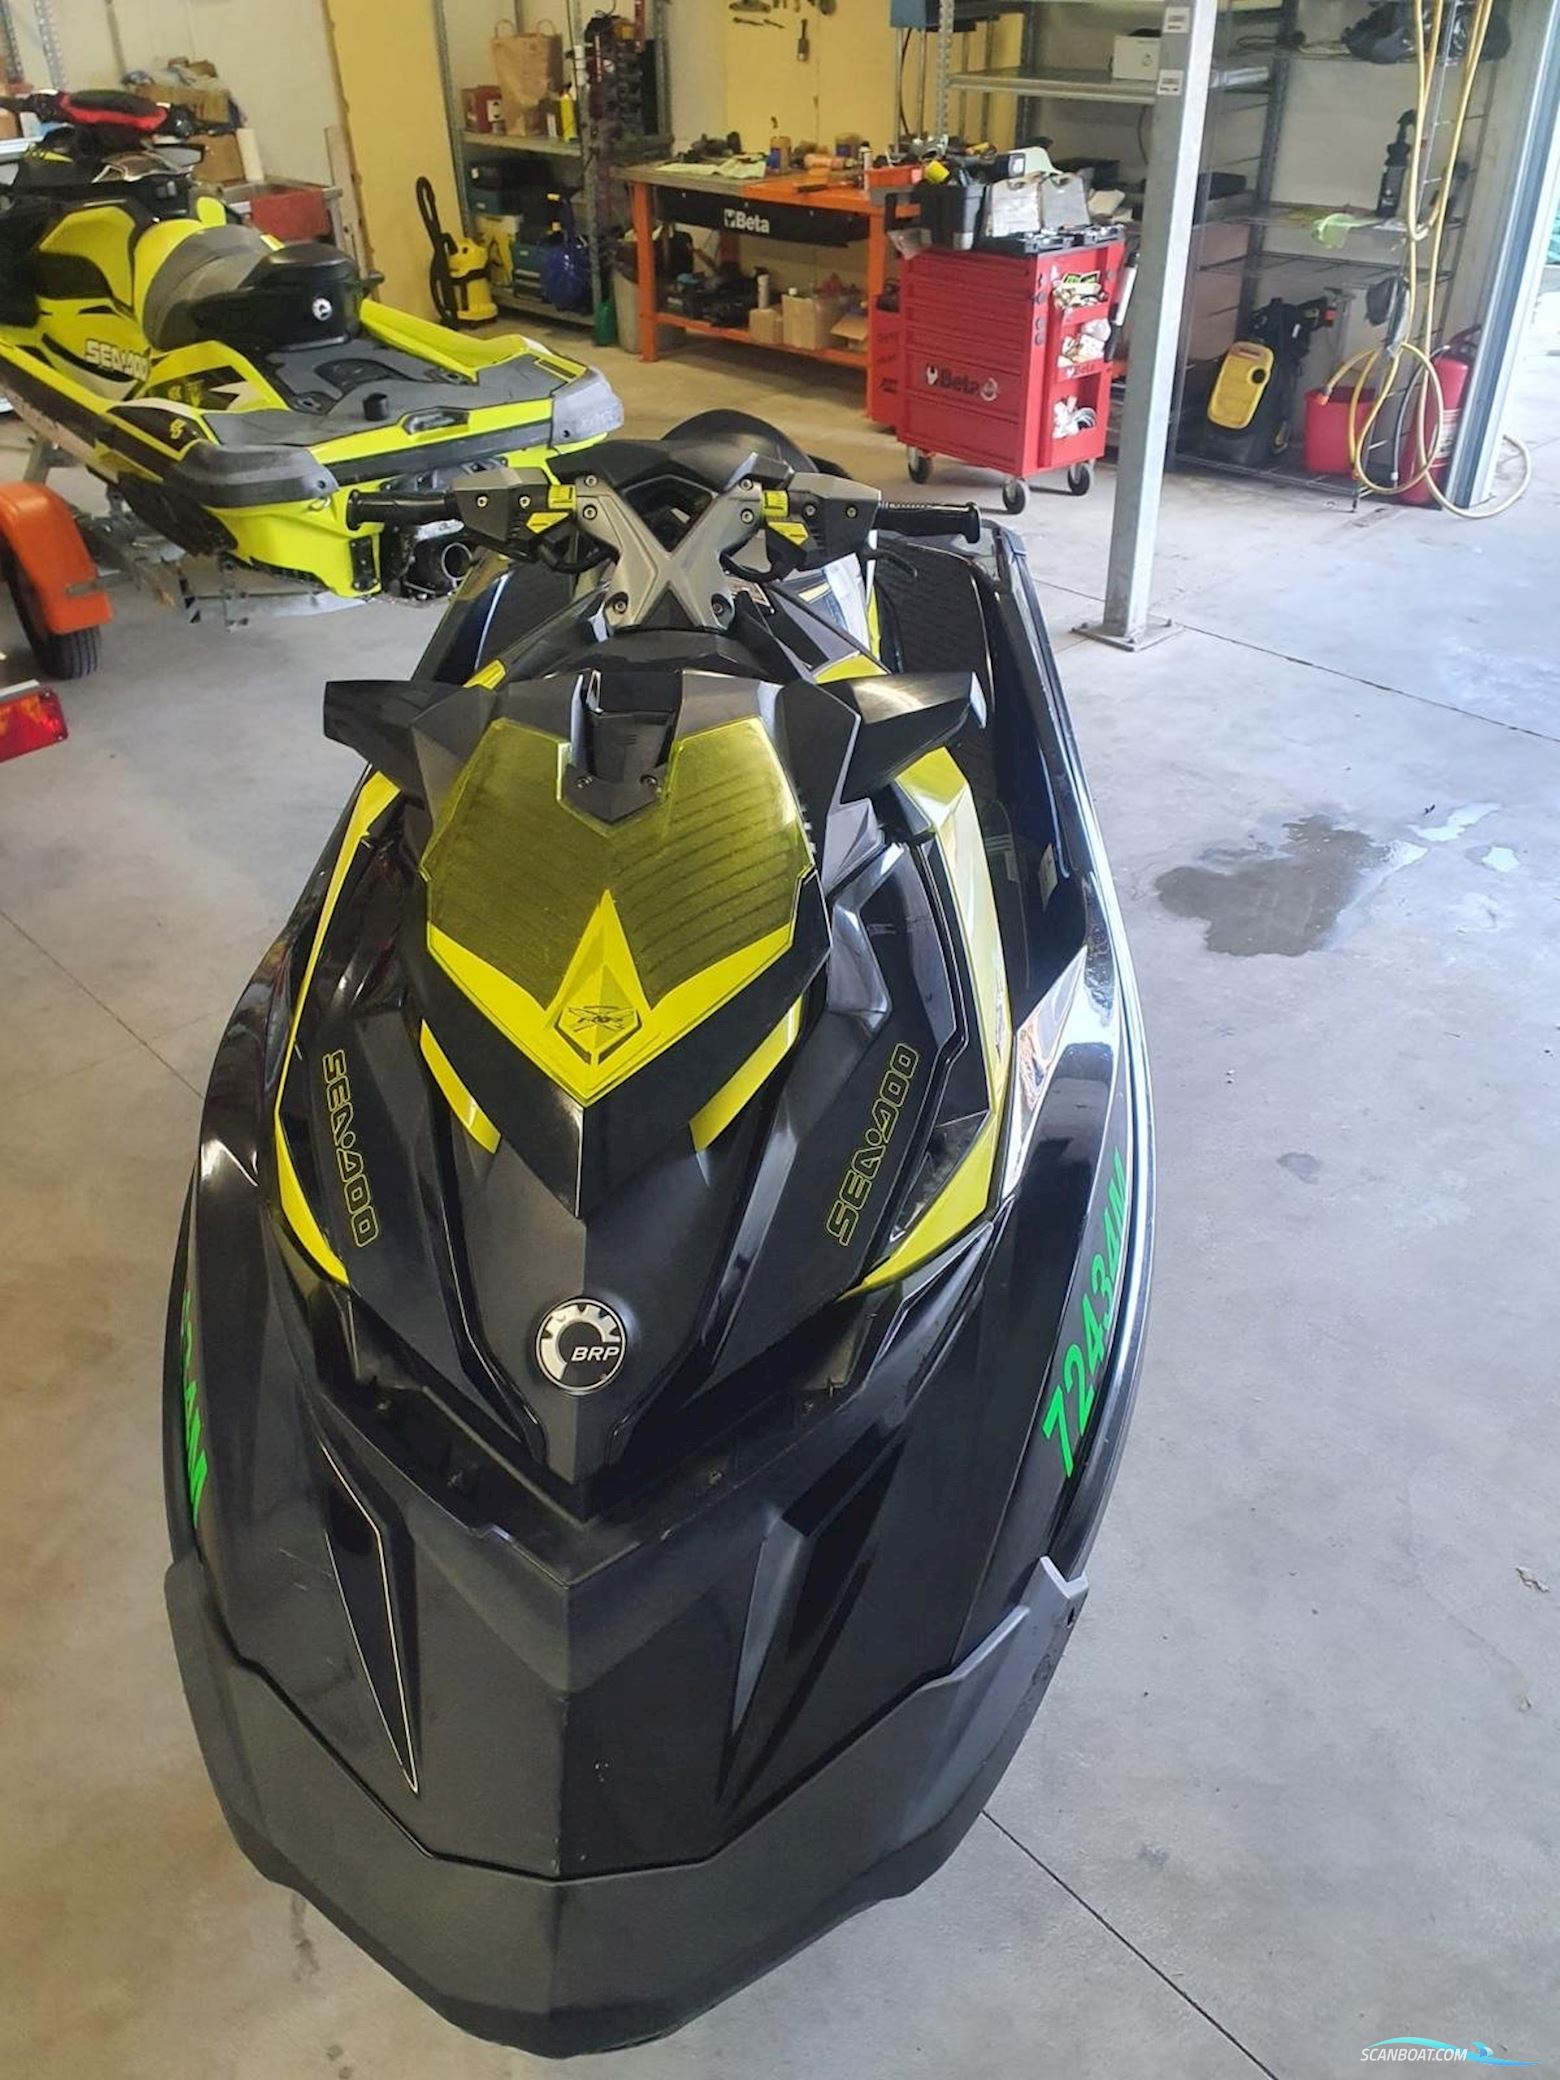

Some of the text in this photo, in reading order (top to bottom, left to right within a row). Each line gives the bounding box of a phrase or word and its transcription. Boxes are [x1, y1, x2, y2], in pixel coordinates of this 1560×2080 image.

[736, 210, 770, 234] Beta
[940, 367, 980, 395] Beta
[570, 1346, 621, 1362] BRP
